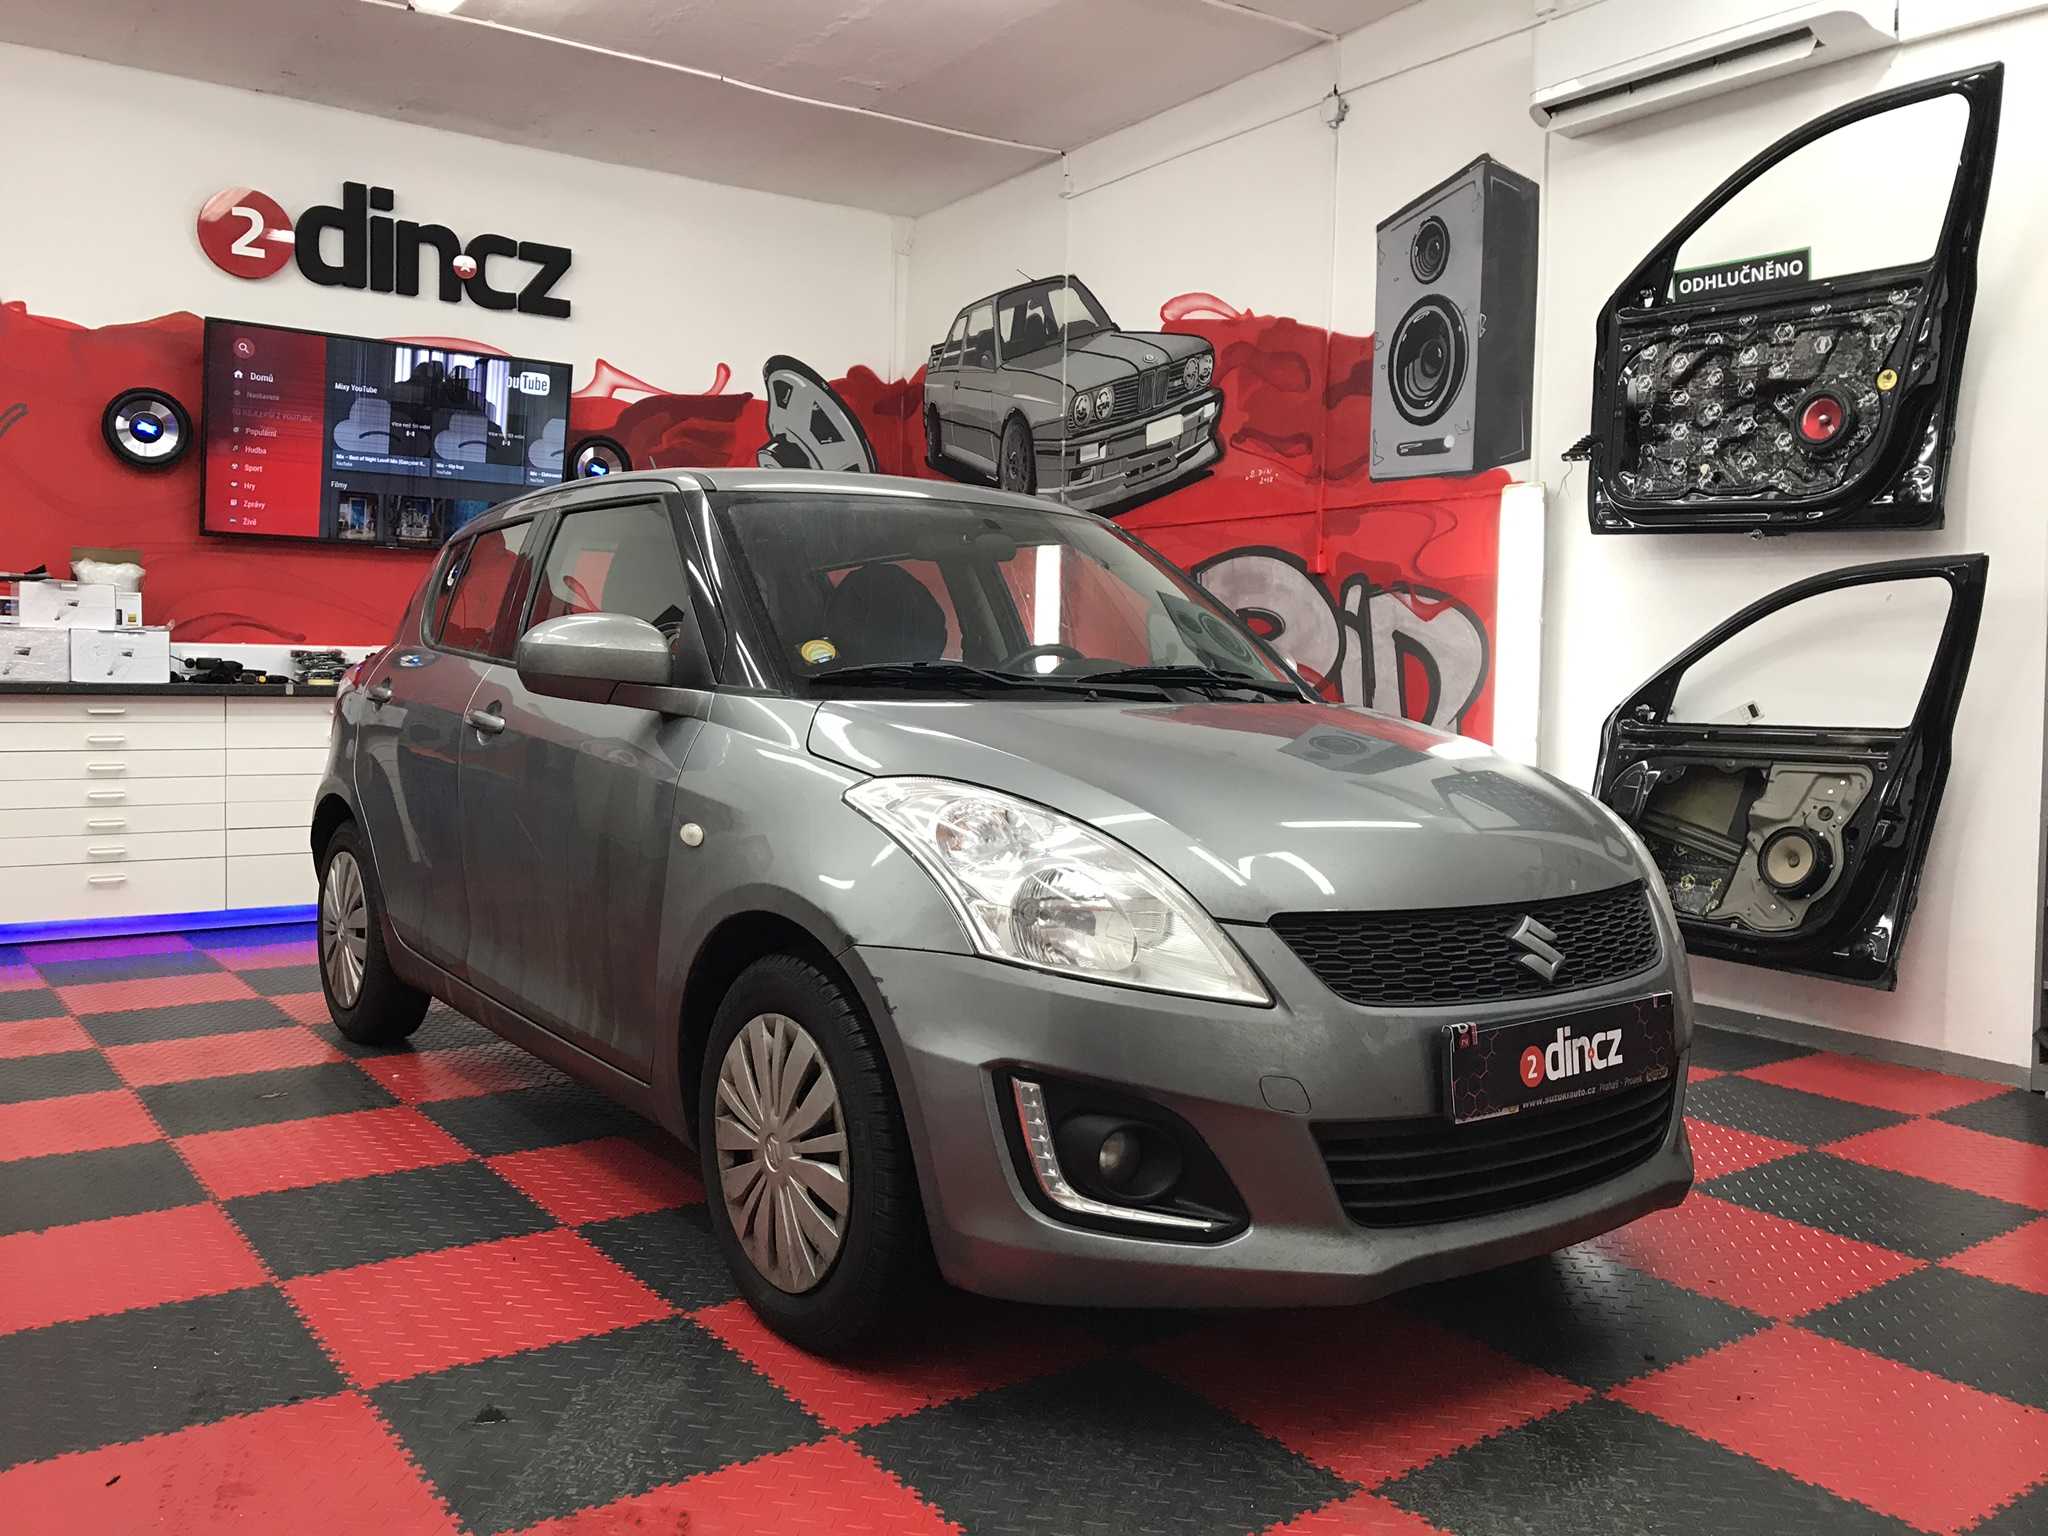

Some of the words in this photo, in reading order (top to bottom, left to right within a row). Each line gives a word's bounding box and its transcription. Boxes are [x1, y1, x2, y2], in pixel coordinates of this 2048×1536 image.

[1679, 259, 1804, 294] ODHLUČNĚNO
[250, 372, 274, 383] Domů
[334, 382, 350, 392] Mixy
[351, 384, 377, 394] YouTube
[245, 445, 267, 455] Hudba
[244, 464, 263, 473] Sport
[244, 482, 256, 492] Hry
[243, 501, 266, 511] Zprávy
